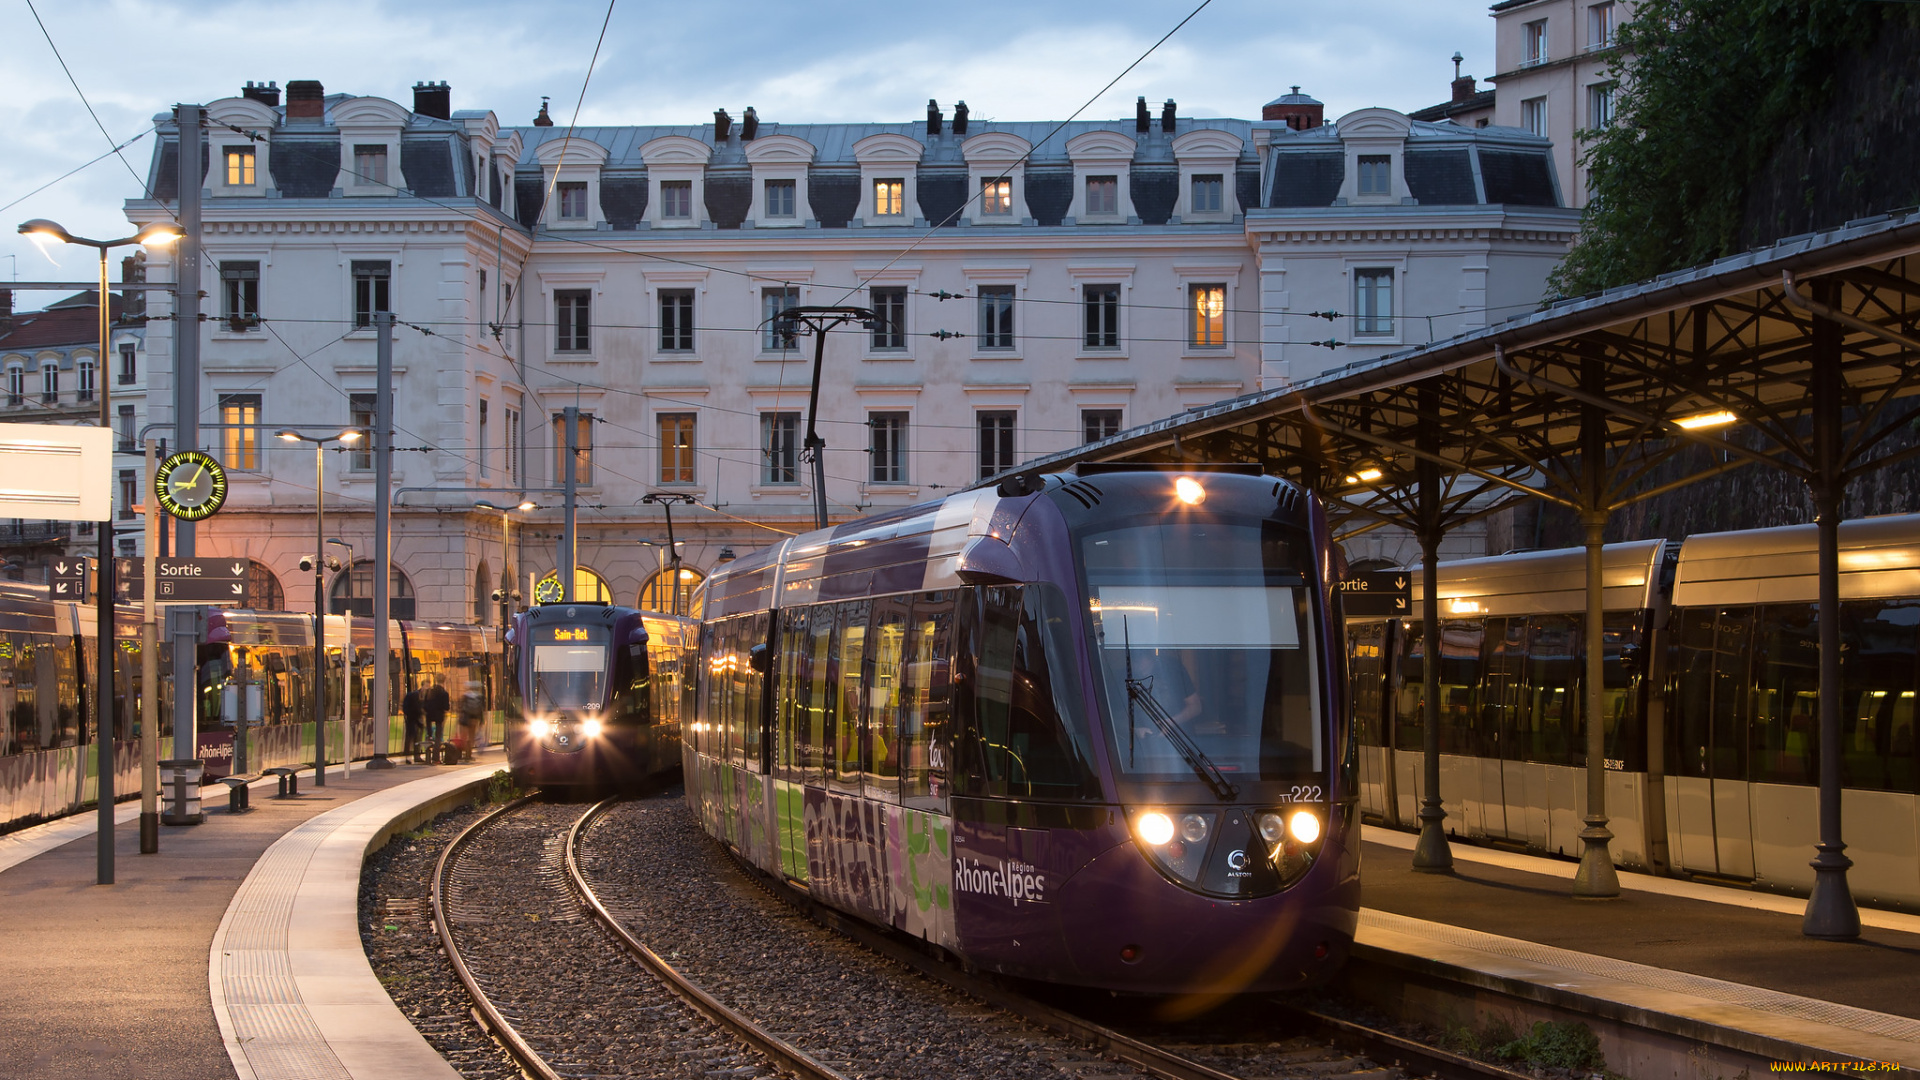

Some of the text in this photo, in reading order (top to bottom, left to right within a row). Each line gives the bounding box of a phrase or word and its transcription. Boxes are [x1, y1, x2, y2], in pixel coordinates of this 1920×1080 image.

[160, 563, 202, 576] Sortie
[1340, 578, 1368, 591] ortie
[554, 627, 589, 641] Sain-Bel
[1011, 861, 1035, 875] Région
